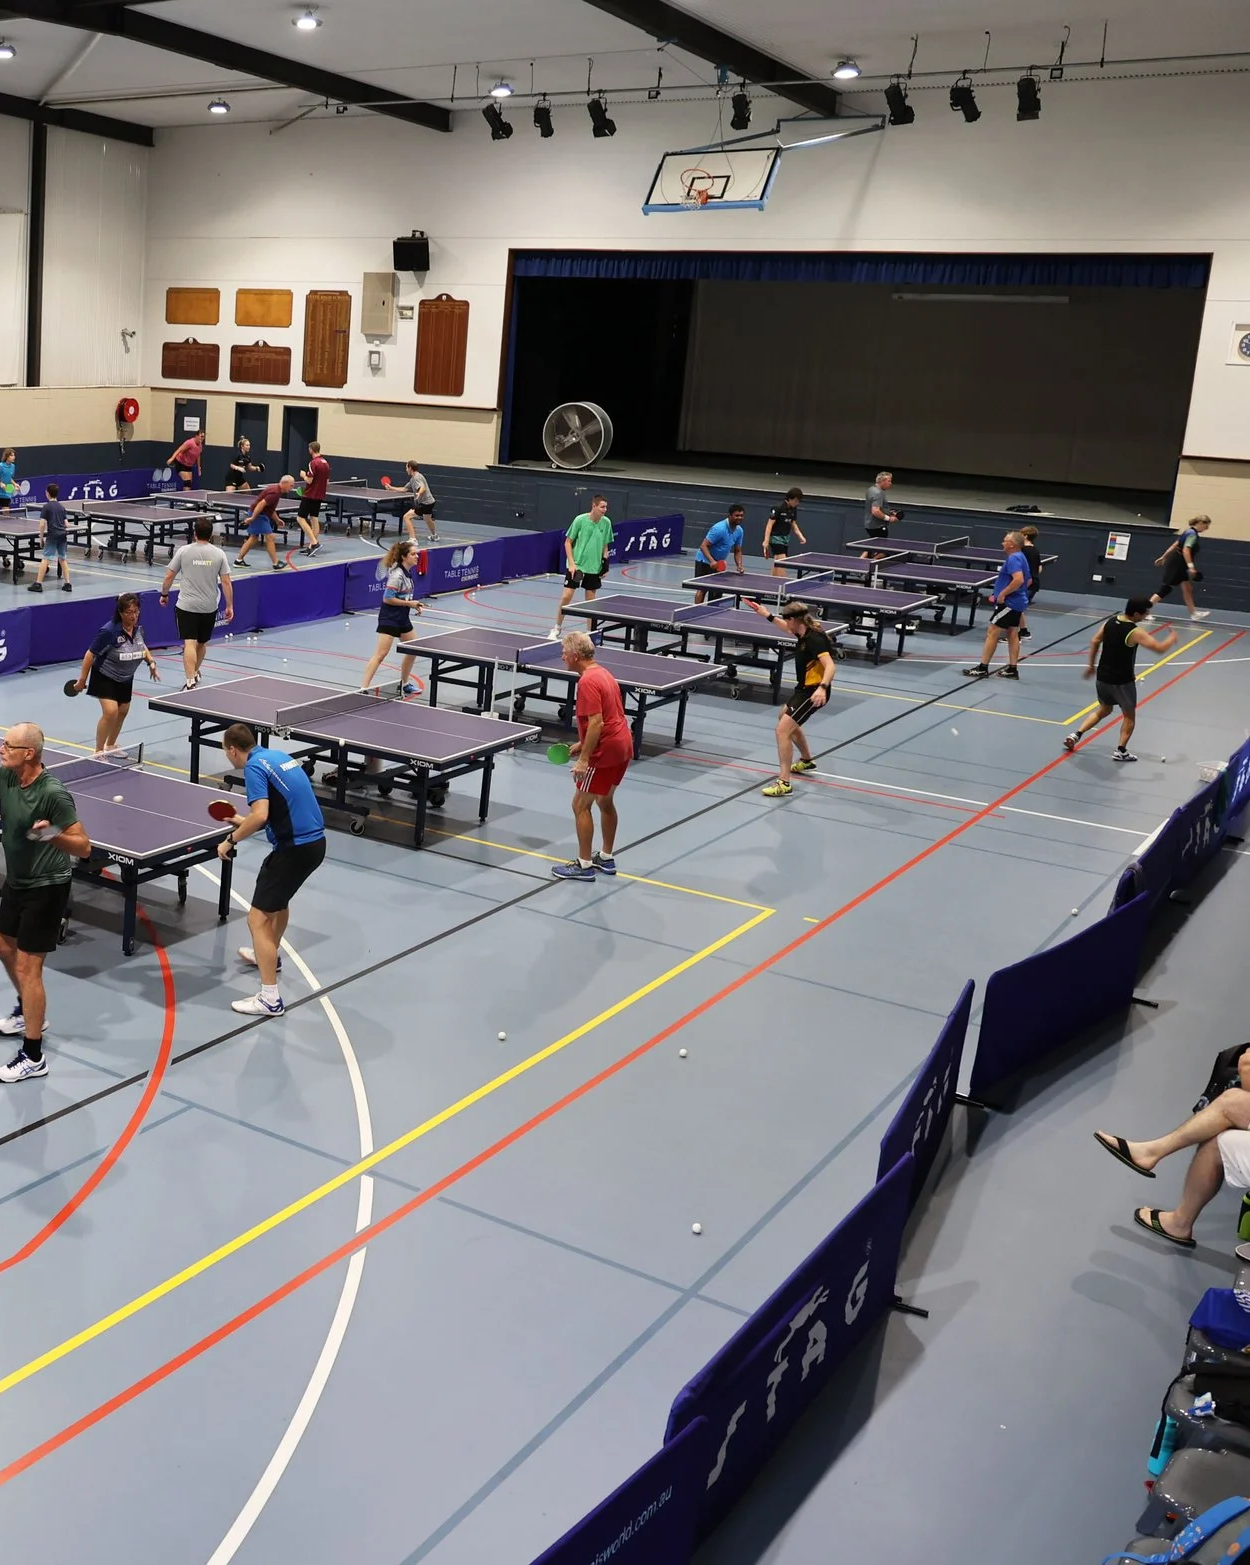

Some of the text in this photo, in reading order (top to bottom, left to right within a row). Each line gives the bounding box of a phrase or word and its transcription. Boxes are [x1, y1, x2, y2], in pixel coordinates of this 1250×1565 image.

[68, 484, 118, 500] STAG
[625, 533, 671, 551] STAG
[444, 570, 461, 579] TABLE
[461, 566, 479, 576] TENNIS
[634, 687, 655, 696] XIOM
[410, 758, 434, 769] XIOM
[107, 852, 134, 866] XIOM
[707, 1260, 870, 1490] STAG
